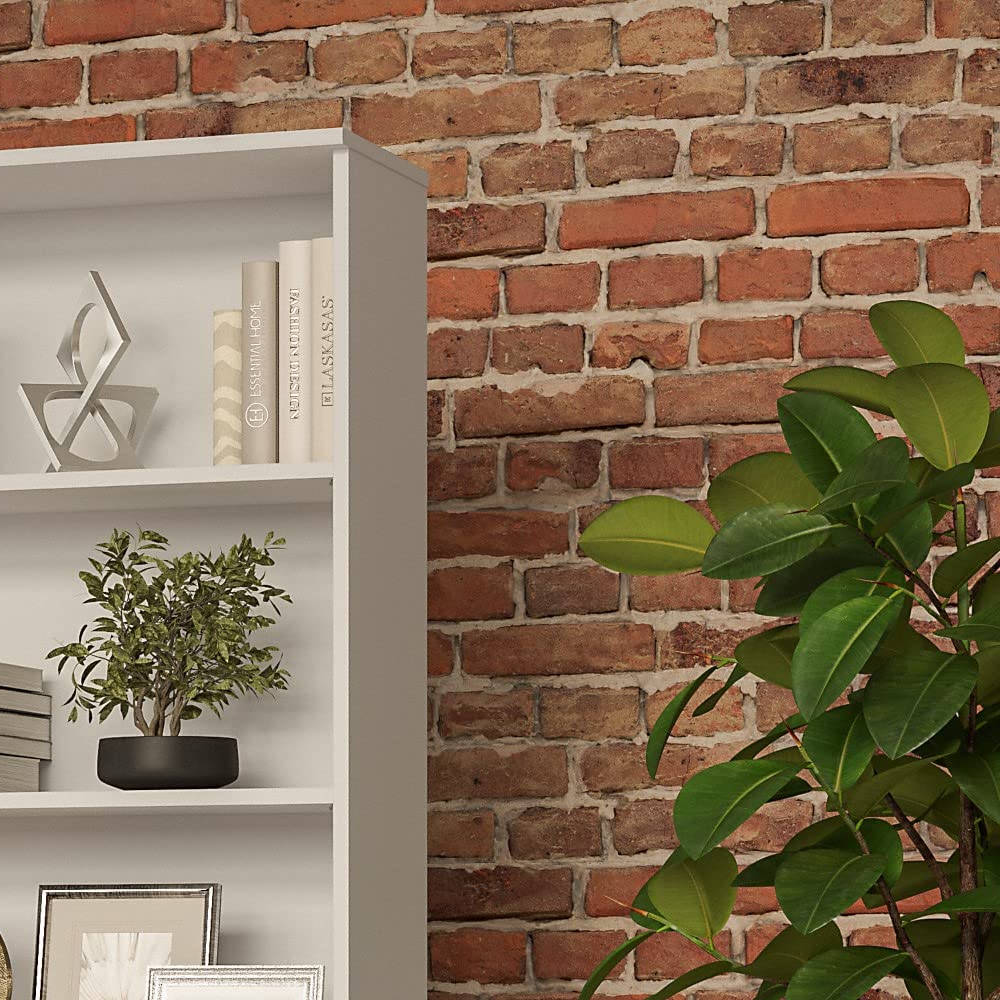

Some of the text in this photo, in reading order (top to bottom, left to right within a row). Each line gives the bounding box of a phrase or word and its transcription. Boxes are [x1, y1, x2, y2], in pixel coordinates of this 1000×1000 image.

[249, 300, 262, 397] ESSENTIAL HOME
[289, 288, 300, 419] FASHION DESIGN
